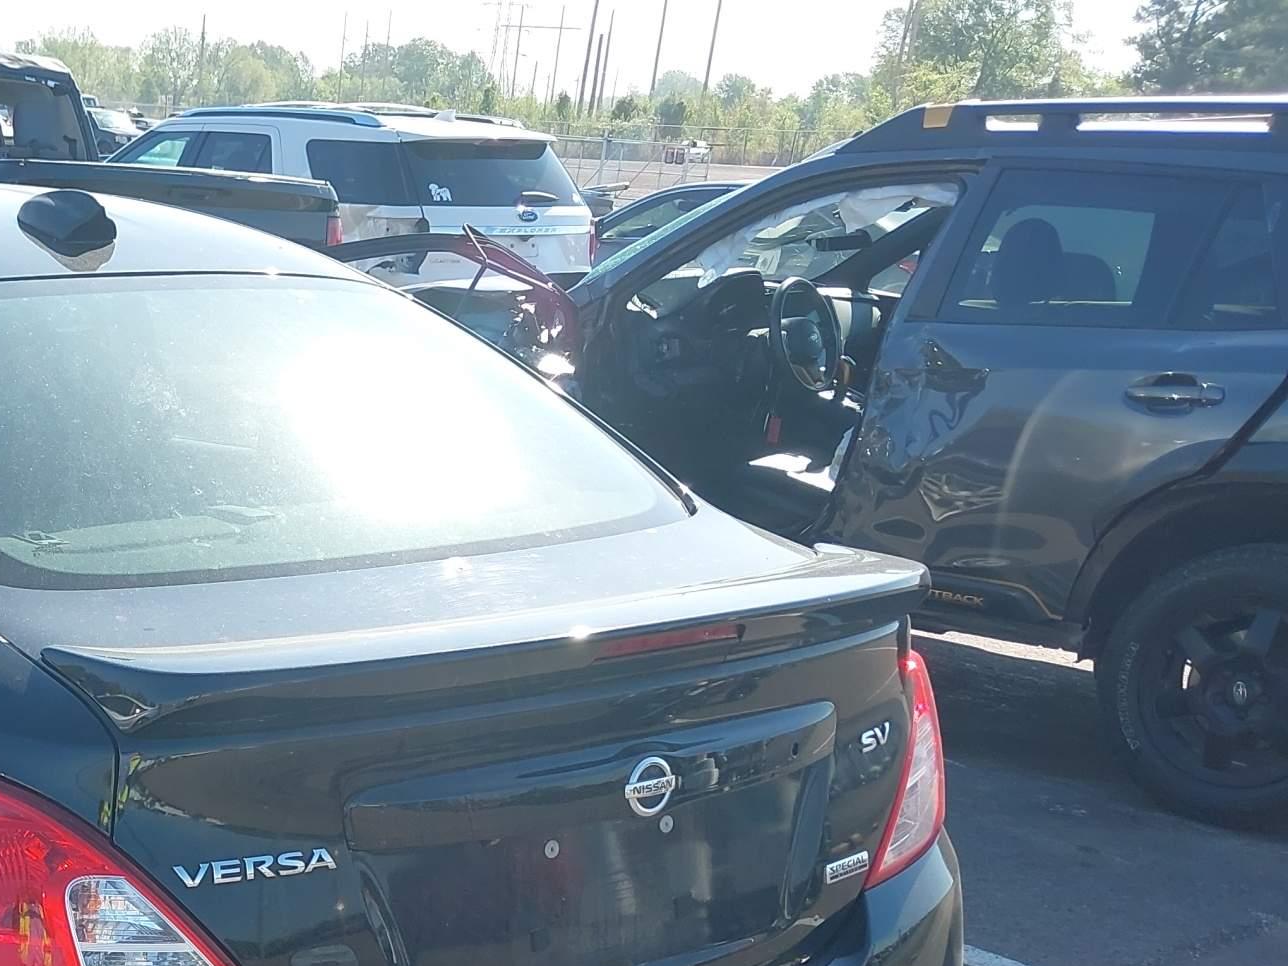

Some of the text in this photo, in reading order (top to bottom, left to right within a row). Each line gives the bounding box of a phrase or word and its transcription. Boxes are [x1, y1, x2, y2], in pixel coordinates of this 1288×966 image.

[860, 722, 890, 753] SV
[632, 778, 674, 795] NISSAN
[173, 848, 337, 888] VERSA
[829, 855, 867, 875] SPECIAL
